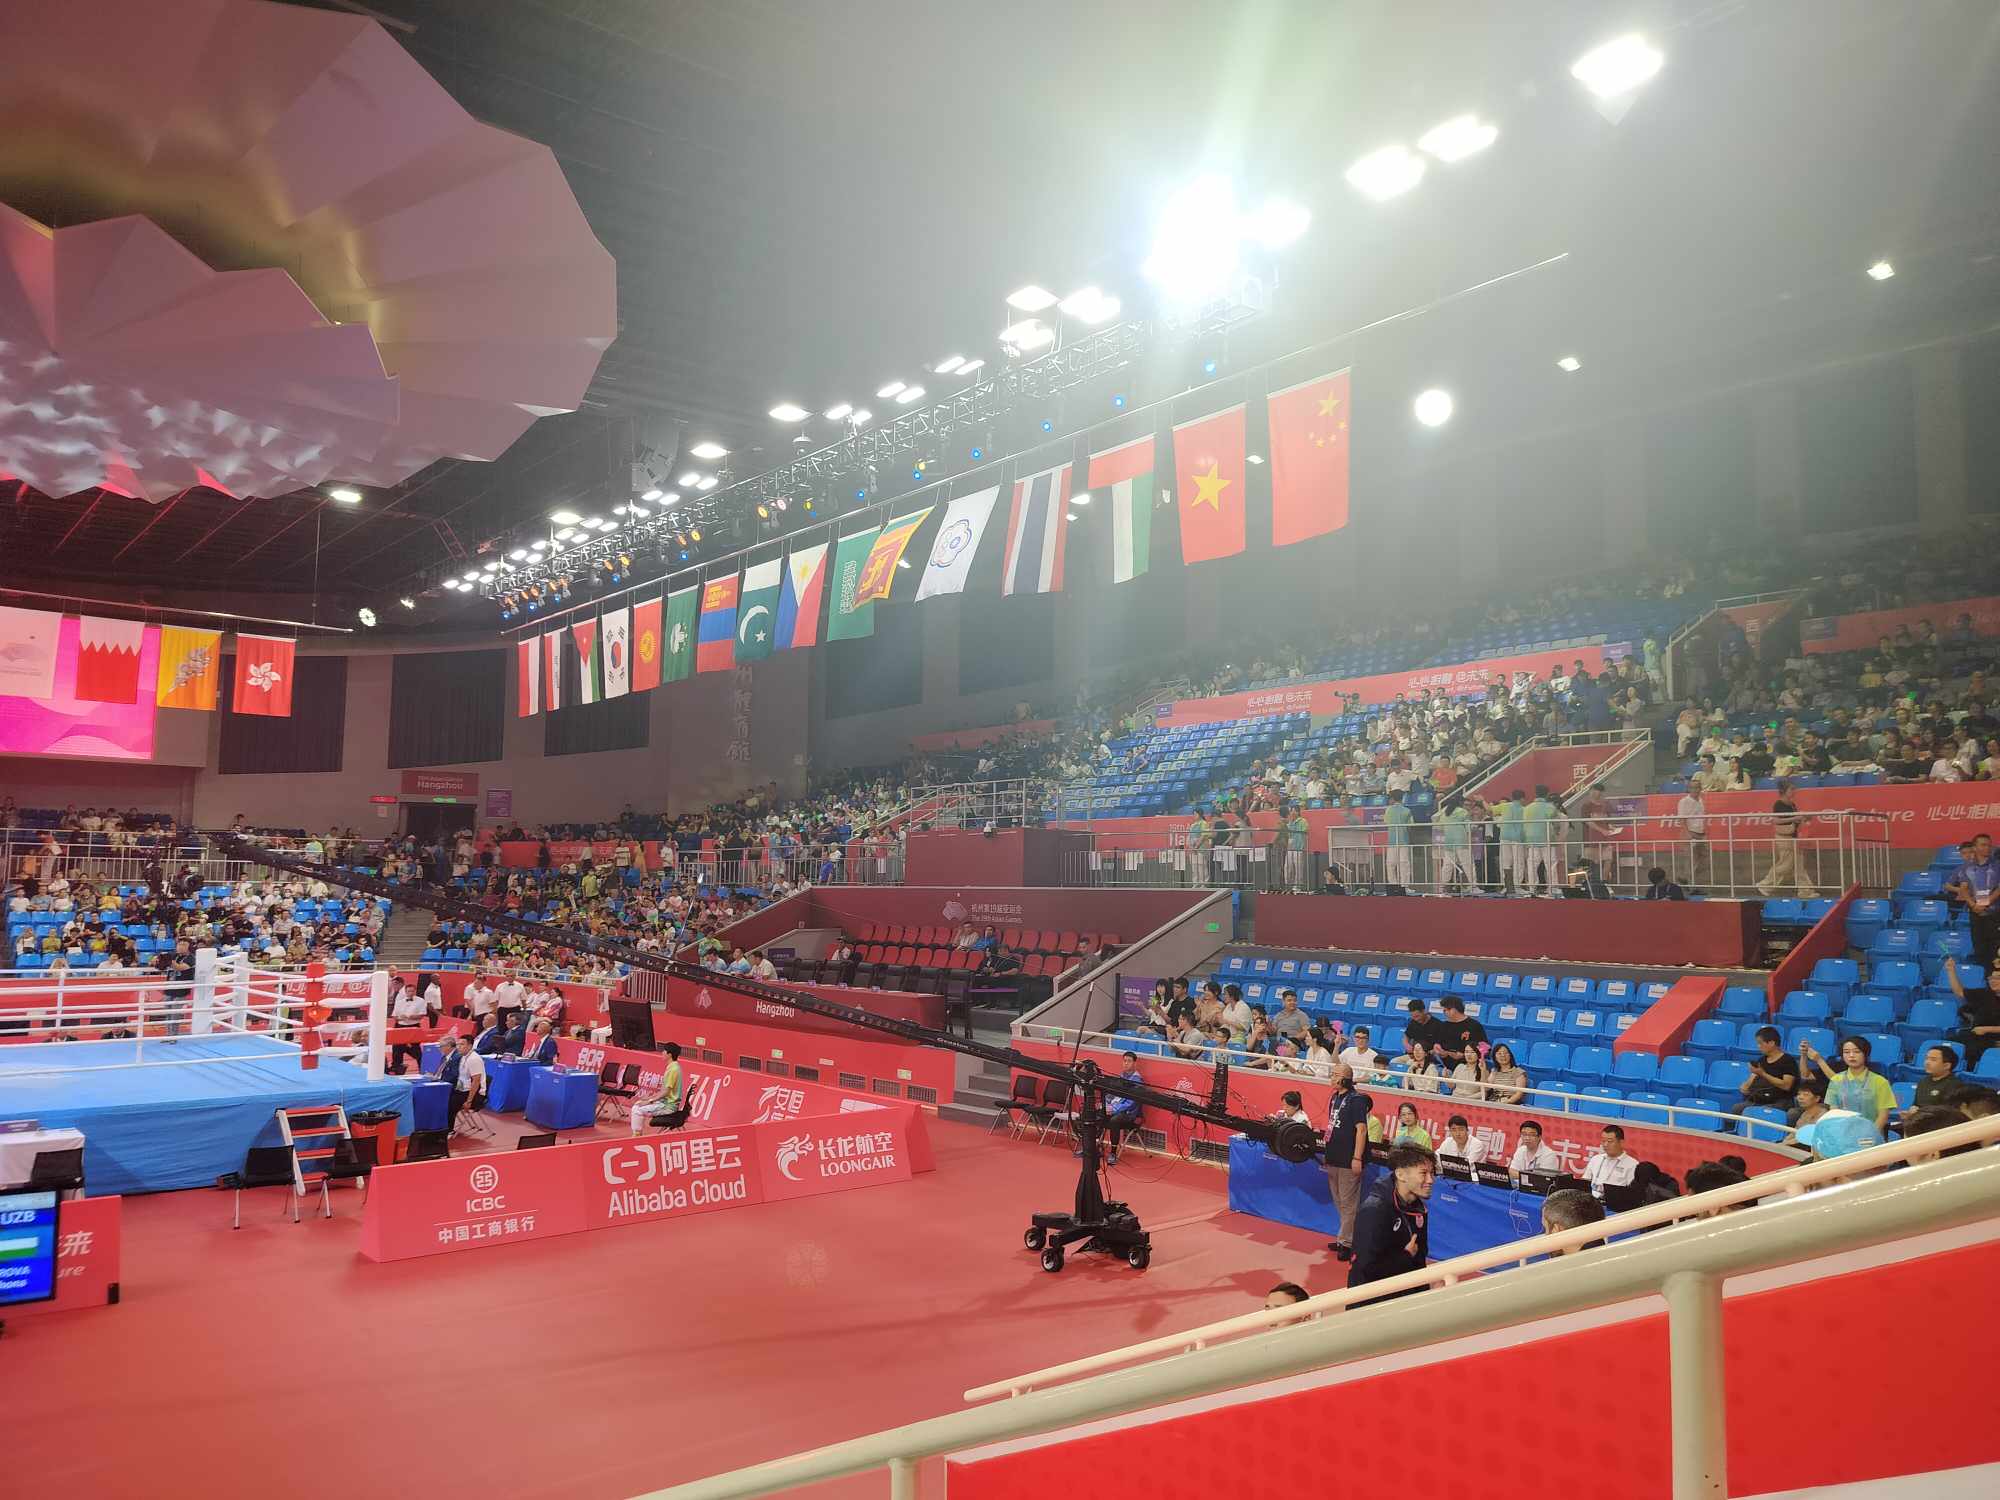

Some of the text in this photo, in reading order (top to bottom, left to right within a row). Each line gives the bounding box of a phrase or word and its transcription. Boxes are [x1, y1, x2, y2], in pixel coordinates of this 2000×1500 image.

[756, 1000, 795, 1018] Hangzhou
[660, 1135, 742, 1176] 阿里云
[818, 1131, 895, 1160] 长龙航空
[820, 1154, 896, 1177] LOONGAIR
[466, 1195, 506, 1213] ICBC
[608, 1173, 746, 1218] Alibaba Cloud
[438, 1216, 535, 1244] 中国工商银行
